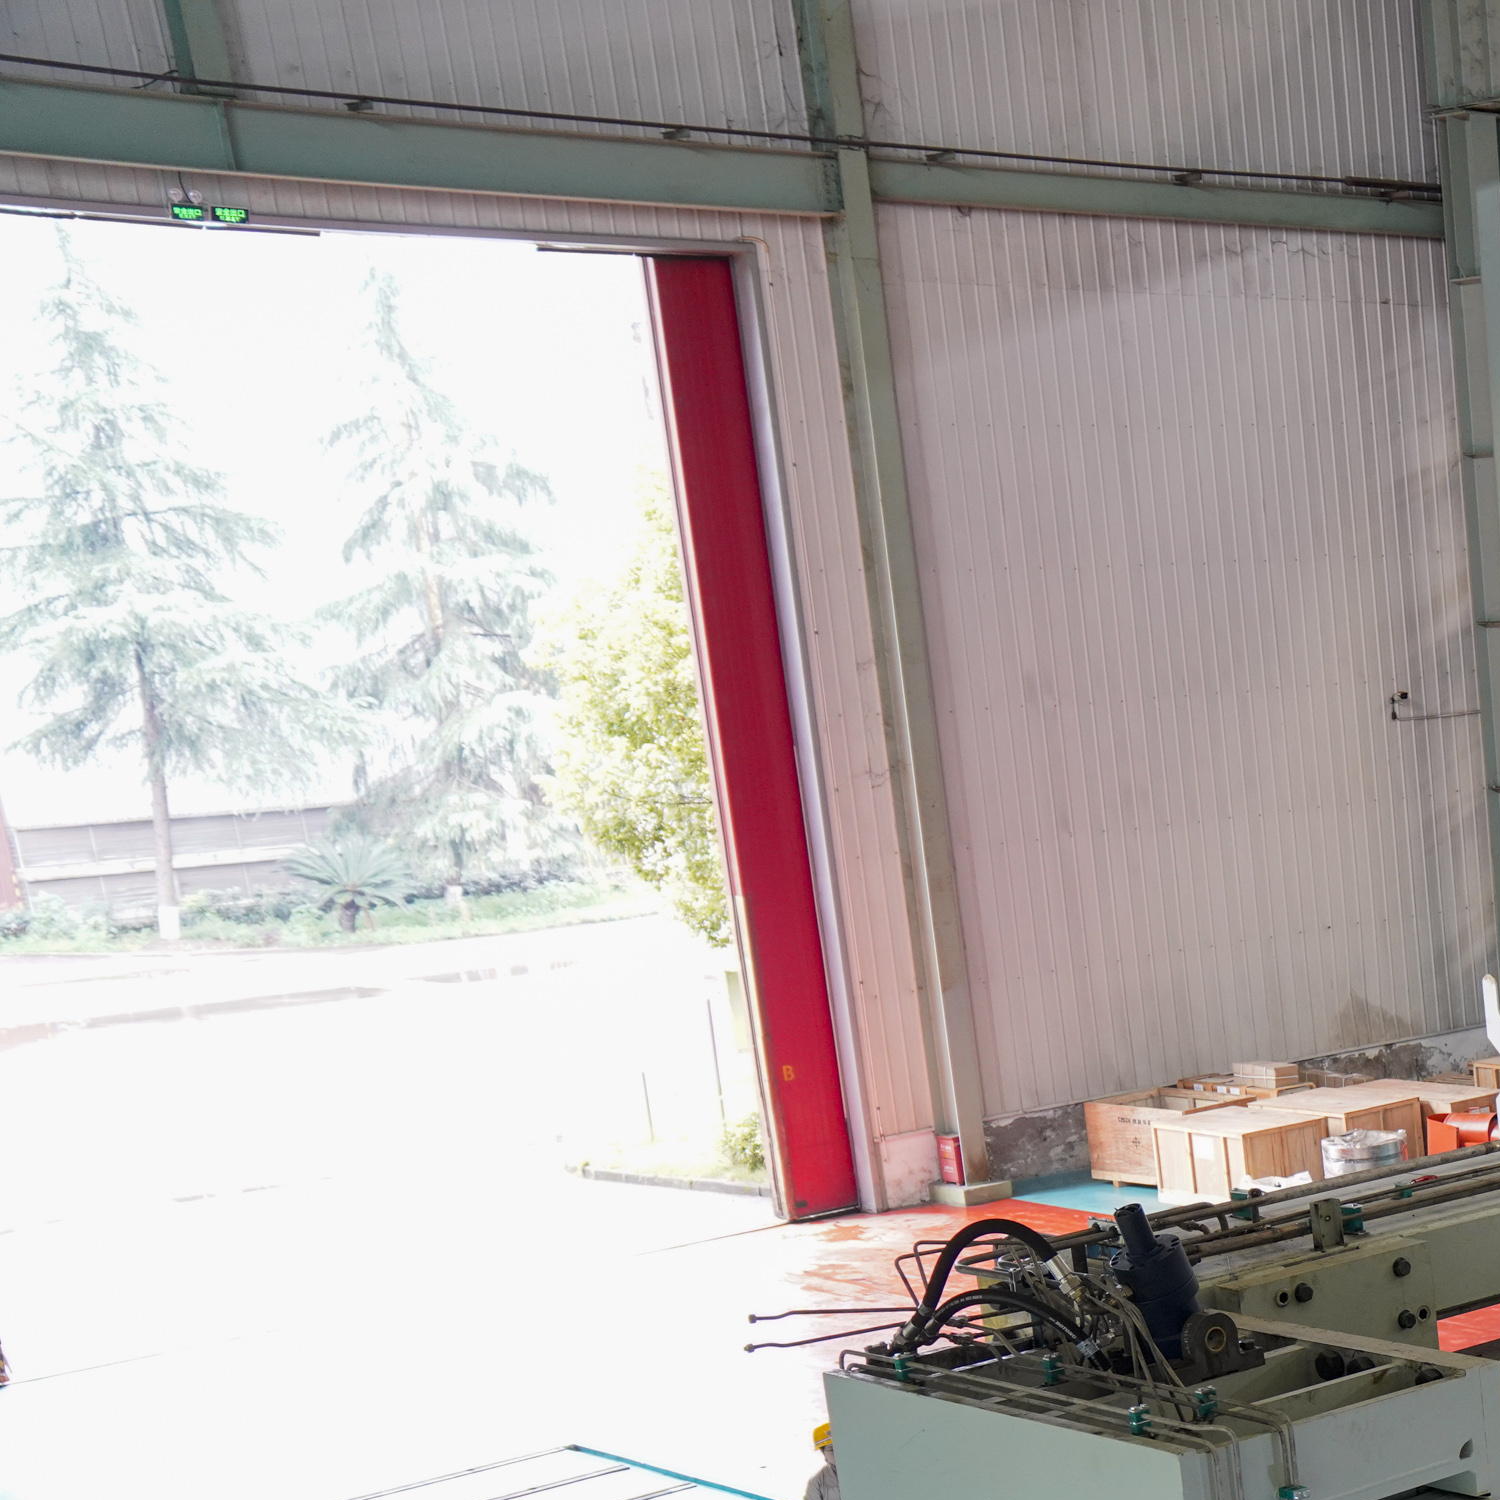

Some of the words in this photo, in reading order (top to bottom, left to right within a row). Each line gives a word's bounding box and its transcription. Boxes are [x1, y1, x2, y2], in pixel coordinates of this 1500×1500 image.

[215, 208, 246, 218] 安全出口
[782, 1064, 795, 1081] B
